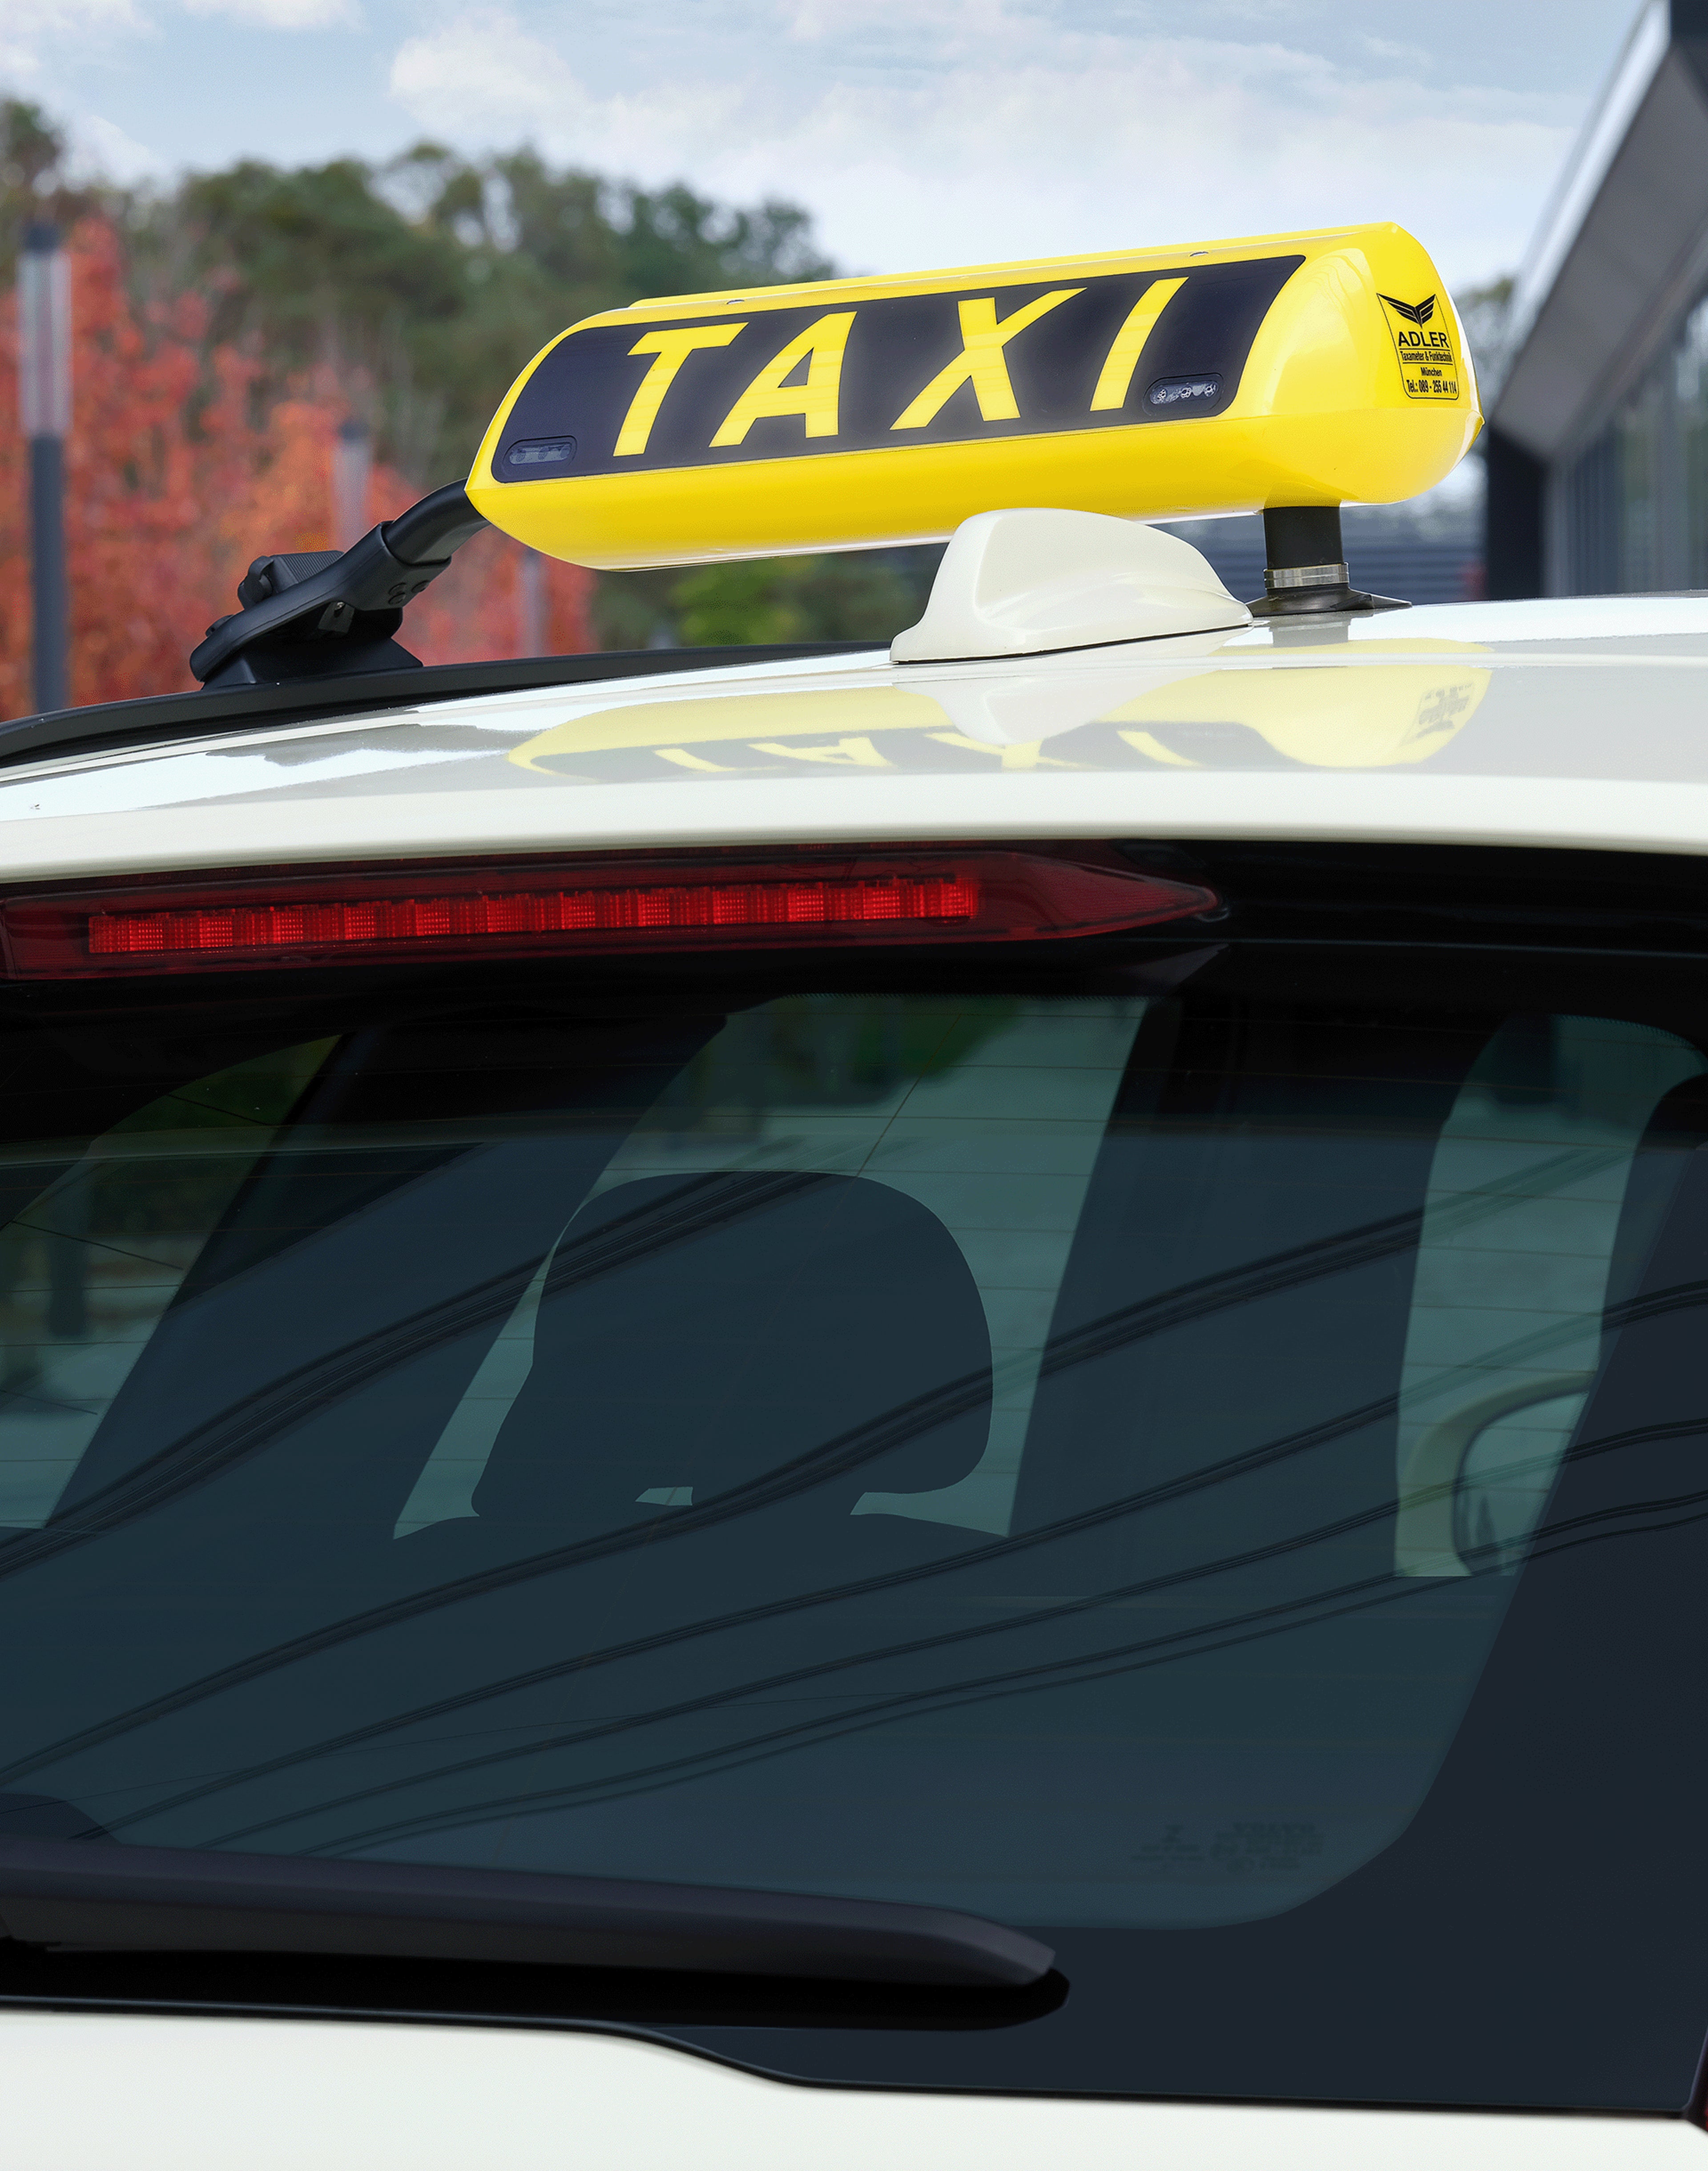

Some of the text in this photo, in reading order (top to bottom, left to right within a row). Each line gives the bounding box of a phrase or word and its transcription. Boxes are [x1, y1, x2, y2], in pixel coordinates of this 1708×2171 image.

[1398, 331, 1449, 348] ADLER
[1400, 351, 1453, 362] Taxameter & Funktechnik
[614, 277, 1189, 457] TAXI
[1420, 367, 1442, 376] München
[1406, 380, 1418, 393] Tel.:
[1419, 380, 1429, 393] 089
[1432, 380, 1442, 394] 255
[1442, 381, 1449, 394] 44
